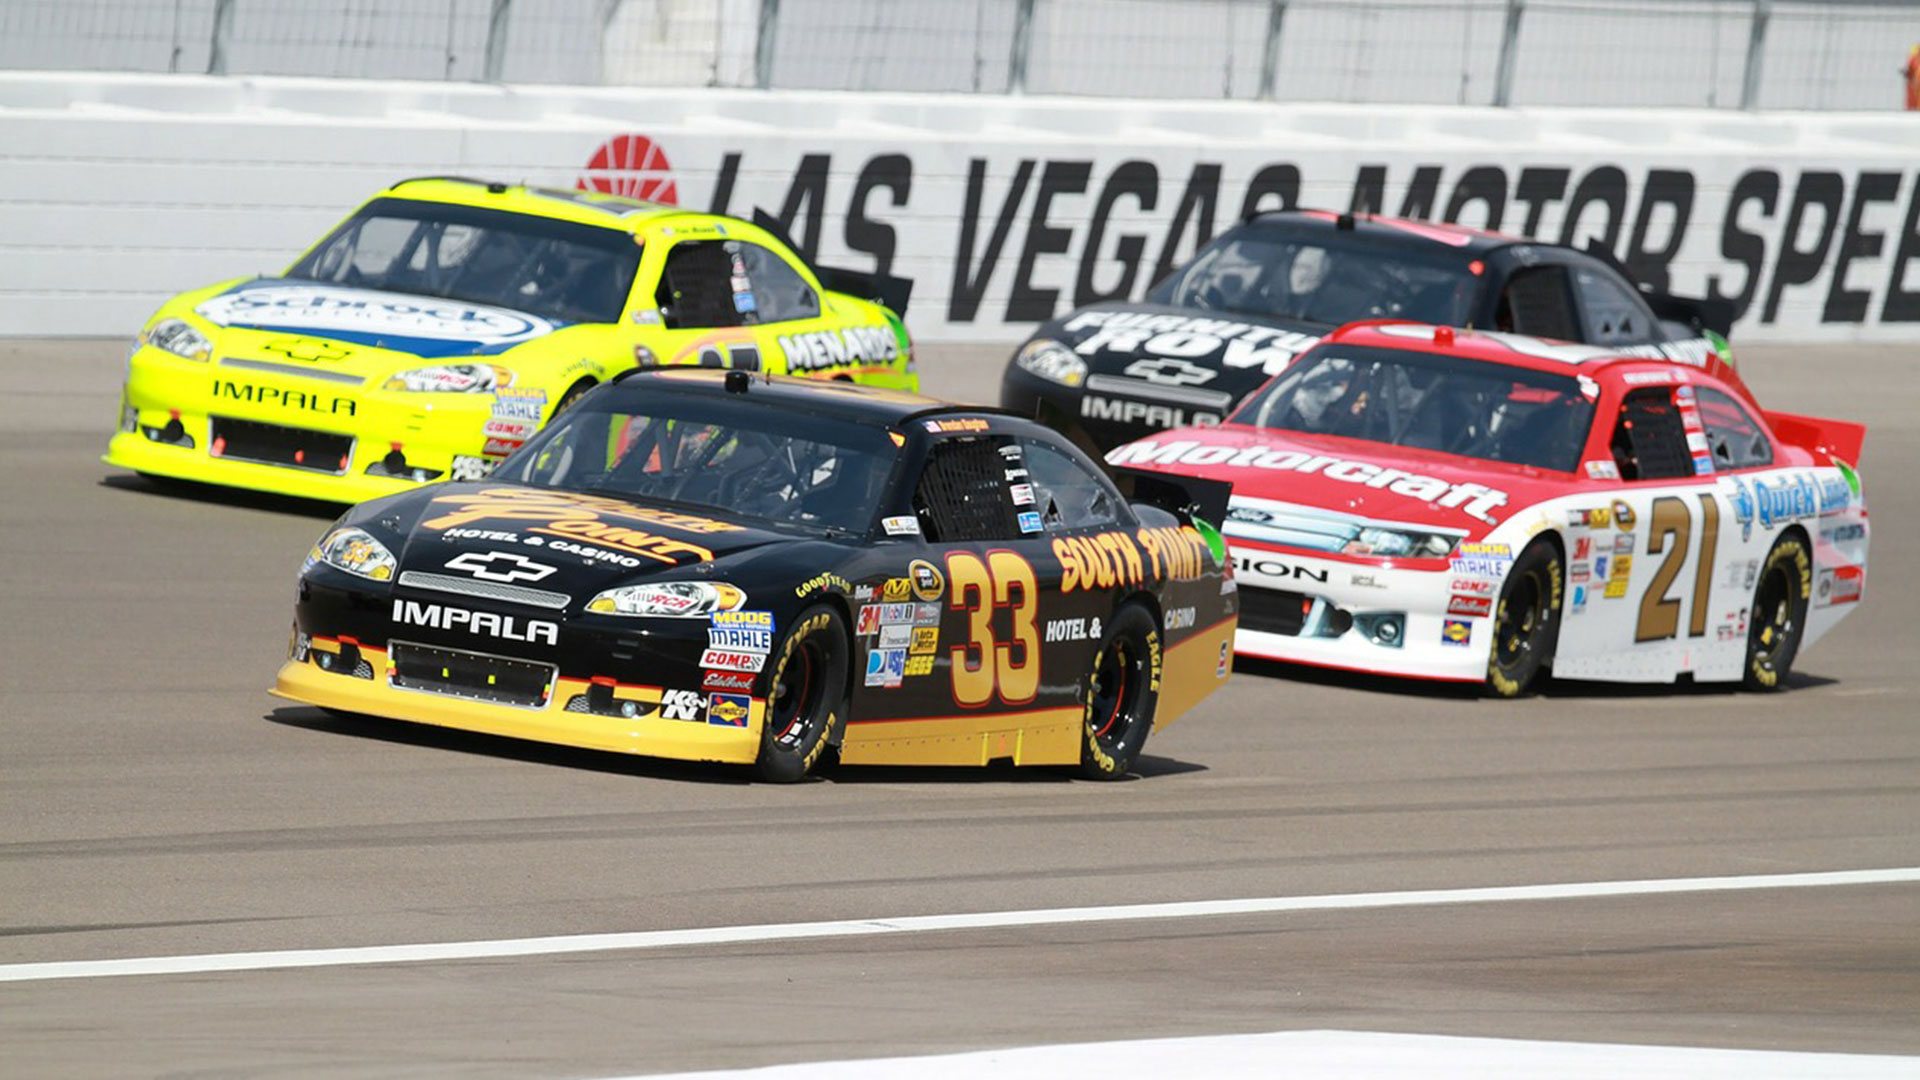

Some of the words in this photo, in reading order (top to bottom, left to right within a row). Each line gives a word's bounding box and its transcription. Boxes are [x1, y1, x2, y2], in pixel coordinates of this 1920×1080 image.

[1350, 164, 1696, 290] TOR
[778, 329, 898, 377] MENARDS
[213, 379, 356, 417] IMPALA
[1081, 396, 1220, 429] IMPALA
[1109, 439, 1508, 524] Motorcraft
[1753, 474, 1816, 529] Quick
[422, 503, 715, 562] POINT
[444, 528, 518, 543] HOTEL
[523, 535, 545, 547] &
[548, 541, 641, 568] CASINO
[343, 541, 374, 564] 33
[1052, 530, 1144, 594] SOUTH
[1136, 525, 1207, 582] POINT
[1452, 560, 1503, 577] MAHLE
[1634, 493, 1720, 643] 21
[392, 599, 559, 645] IMPALA
[713, 612, 772, 625] MOOG
[858, 605, 882, 633] 3M
[944, 550, 1042, 708] 33
[1046, 619, 1087, 642] HOTEL
[1088, 618, 1102, 640] &
[1164, 607, 1197, 630] CASINO
[711, 629, 770, 648] MAHLE
[704, 652, 751, 668] COMP
[1145, 631, 1161, 692] EAGLE
[703, 672, 754, 690] Edelbrock
[661, 689, 708, 720] K&N
